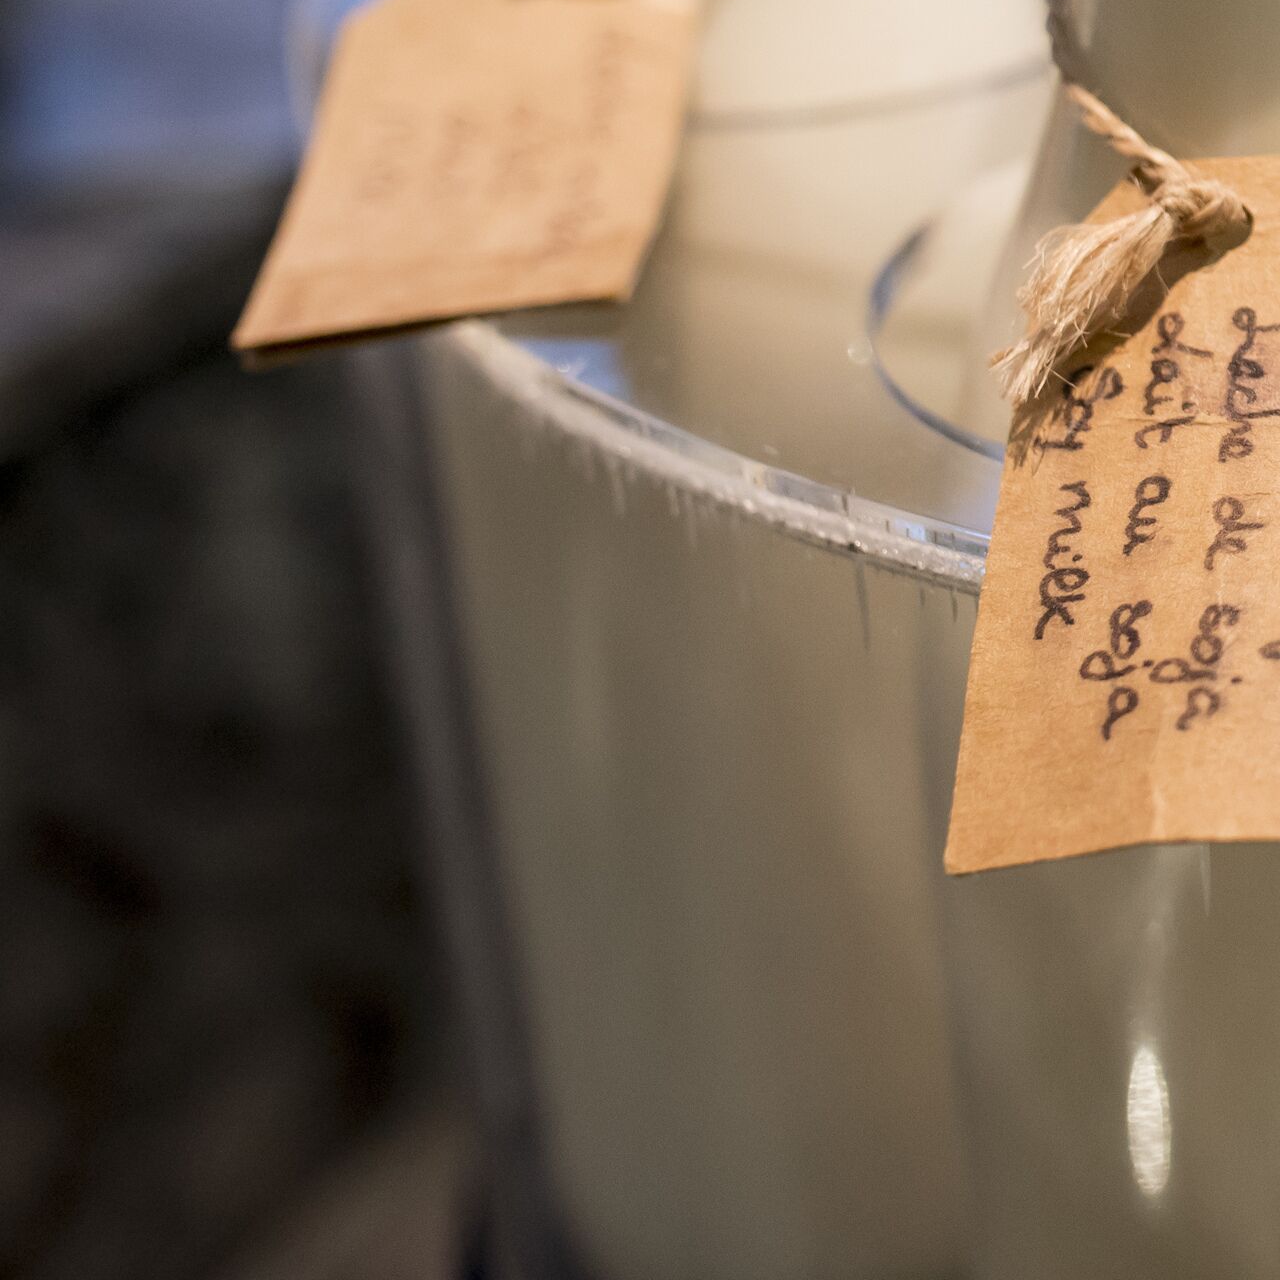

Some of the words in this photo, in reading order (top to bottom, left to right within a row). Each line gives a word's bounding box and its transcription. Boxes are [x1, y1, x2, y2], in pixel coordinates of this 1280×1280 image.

[1033, 366, 1124, 452] Soy
[1133, 312, 1210, 449] Lait
[1033, 482, 1090, 640] milk
[1122, 476, 1172, 556] au
[1203, 497, 1263, 570] de
[1079, 600, 1153, 740] soja
[1150, 604, 1243, 730] soja
